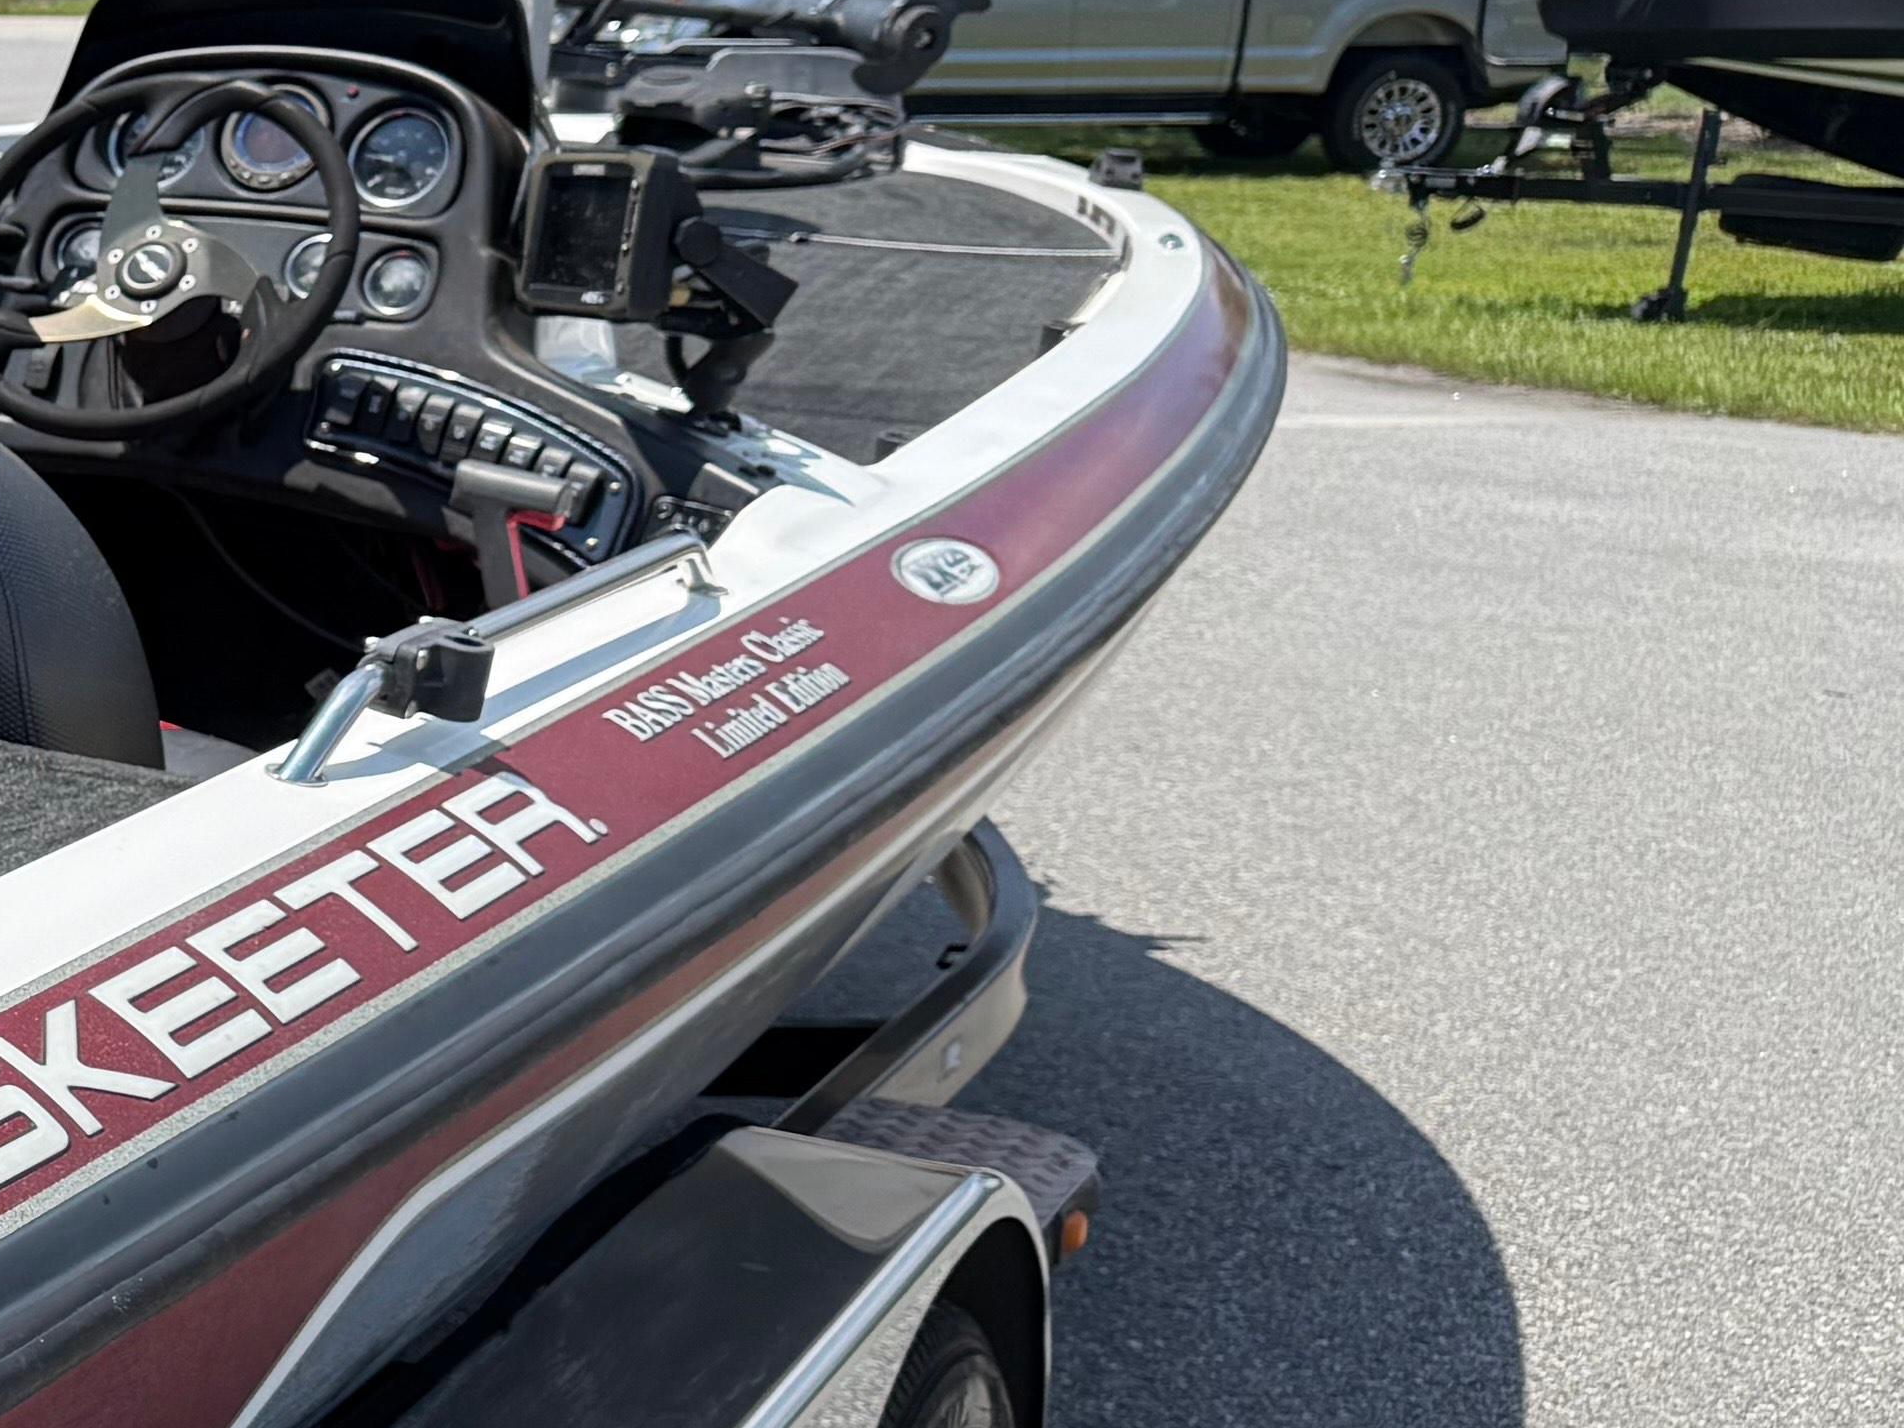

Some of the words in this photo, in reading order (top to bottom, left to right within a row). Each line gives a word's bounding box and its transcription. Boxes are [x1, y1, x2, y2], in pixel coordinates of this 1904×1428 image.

[602, 683, 696, 743] BASS
[665, 651, 769, 708] Masters
[740, 616, 825, 664] Classic
[691, 698, 789, 759] Limited
[766, 660, 852, 714] Edition
